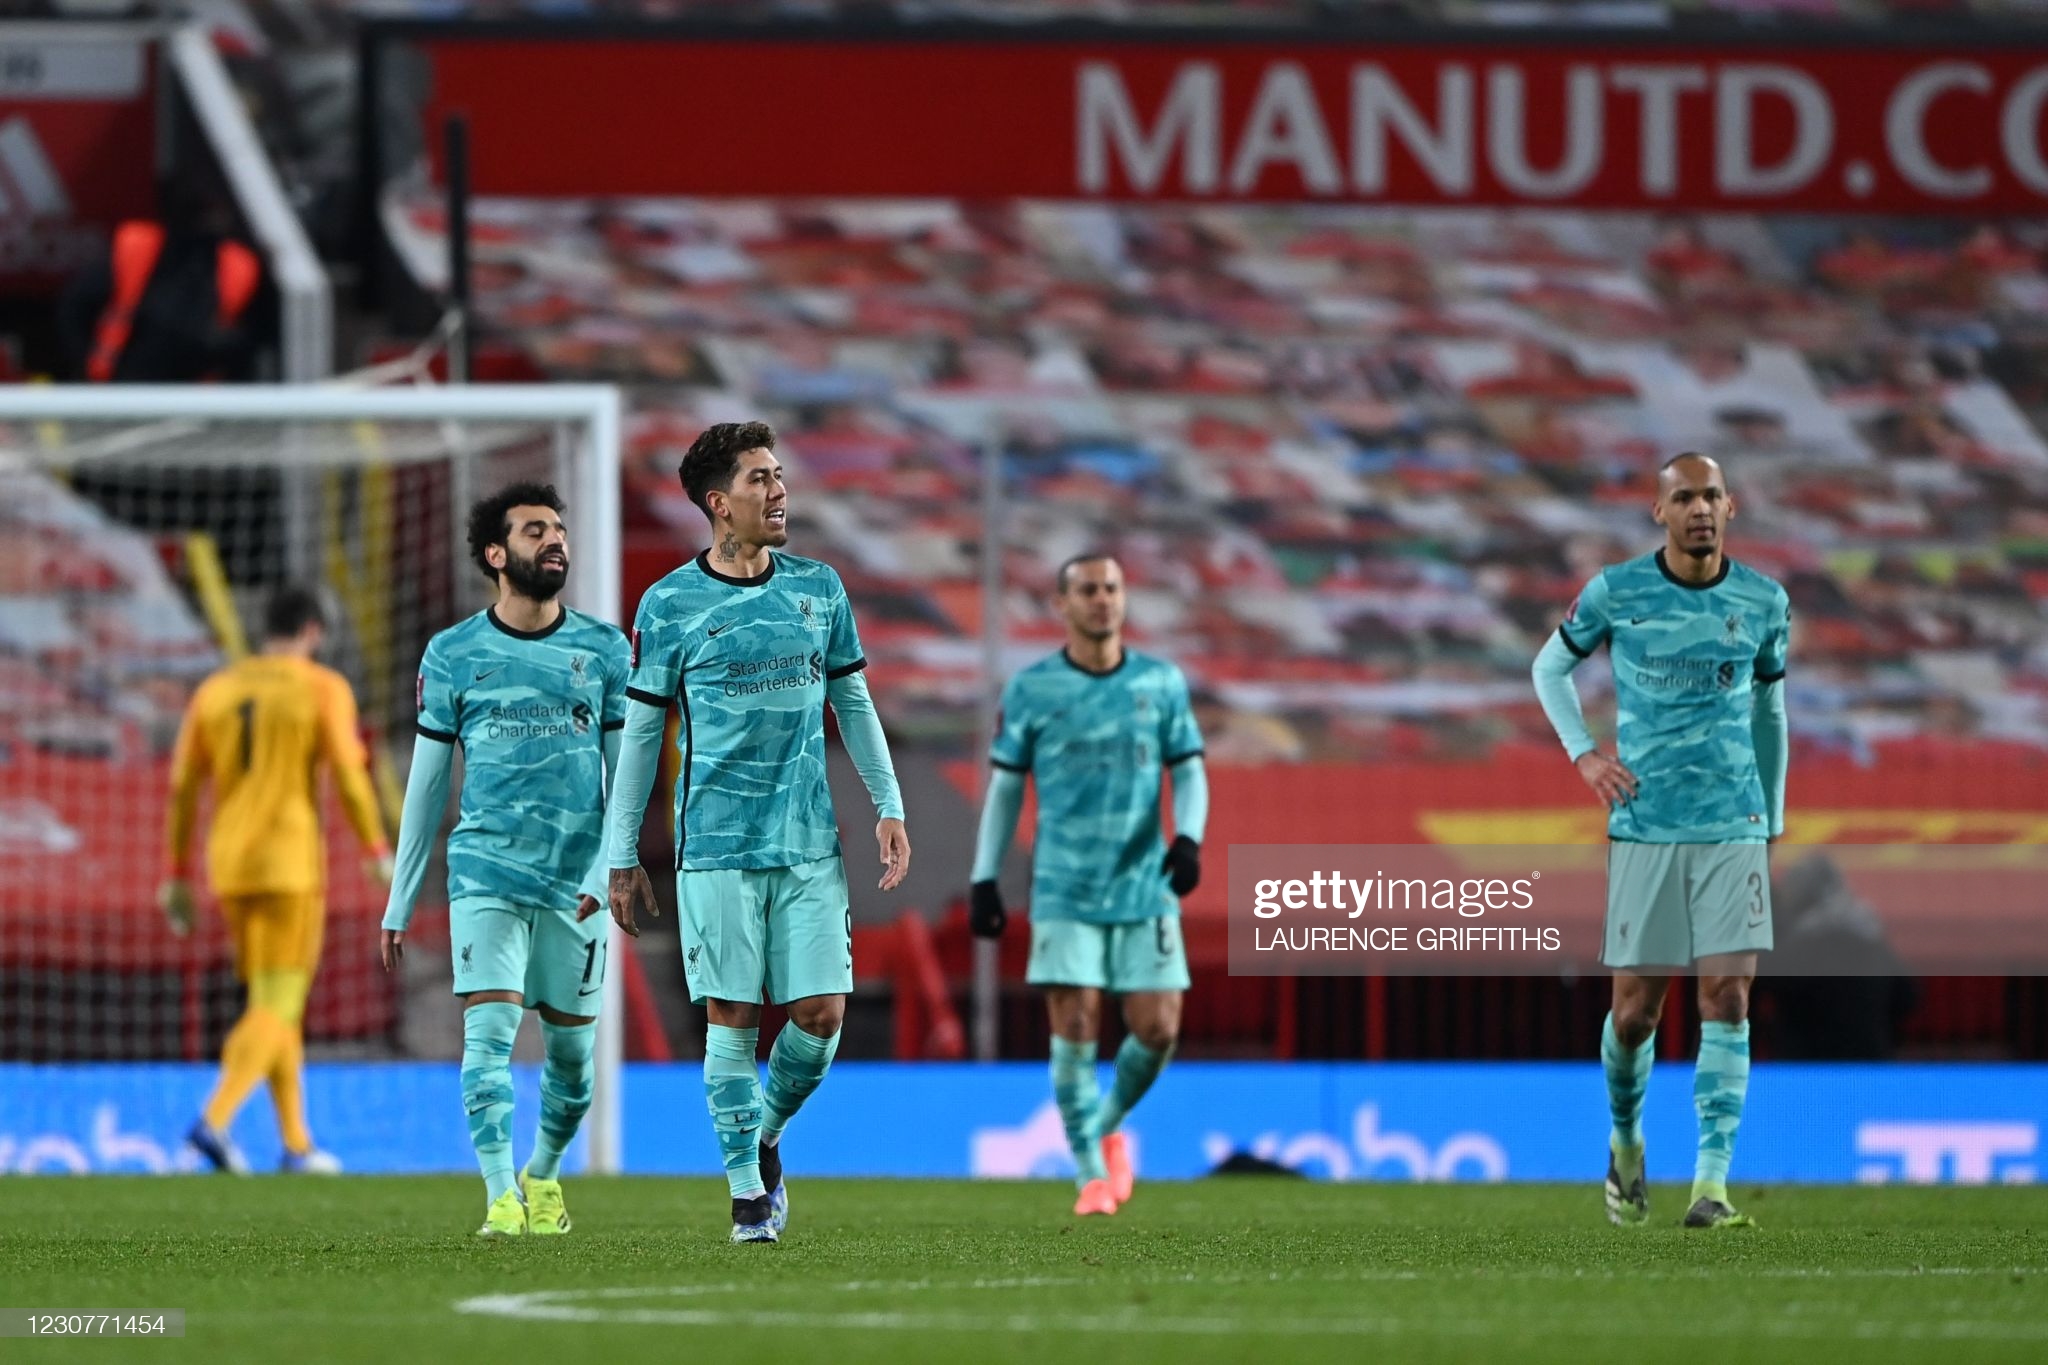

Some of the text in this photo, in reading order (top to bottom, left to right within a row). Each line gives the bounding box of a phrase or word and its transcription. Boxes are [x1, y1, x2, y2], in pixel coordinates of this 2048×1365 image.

[728, 652, 805, 678] Standard
[1641, 655, 1713, 670] Standard
[724, 674, 807, 697] Chartered
[1636, 671, 1712, 688] Chartered
[490, 704, 566, 719] Standard
[237, 698, 256, 770] 1
[488, 721, 568, 738] Chartered
[1748, 872, 1763, 914] 3
